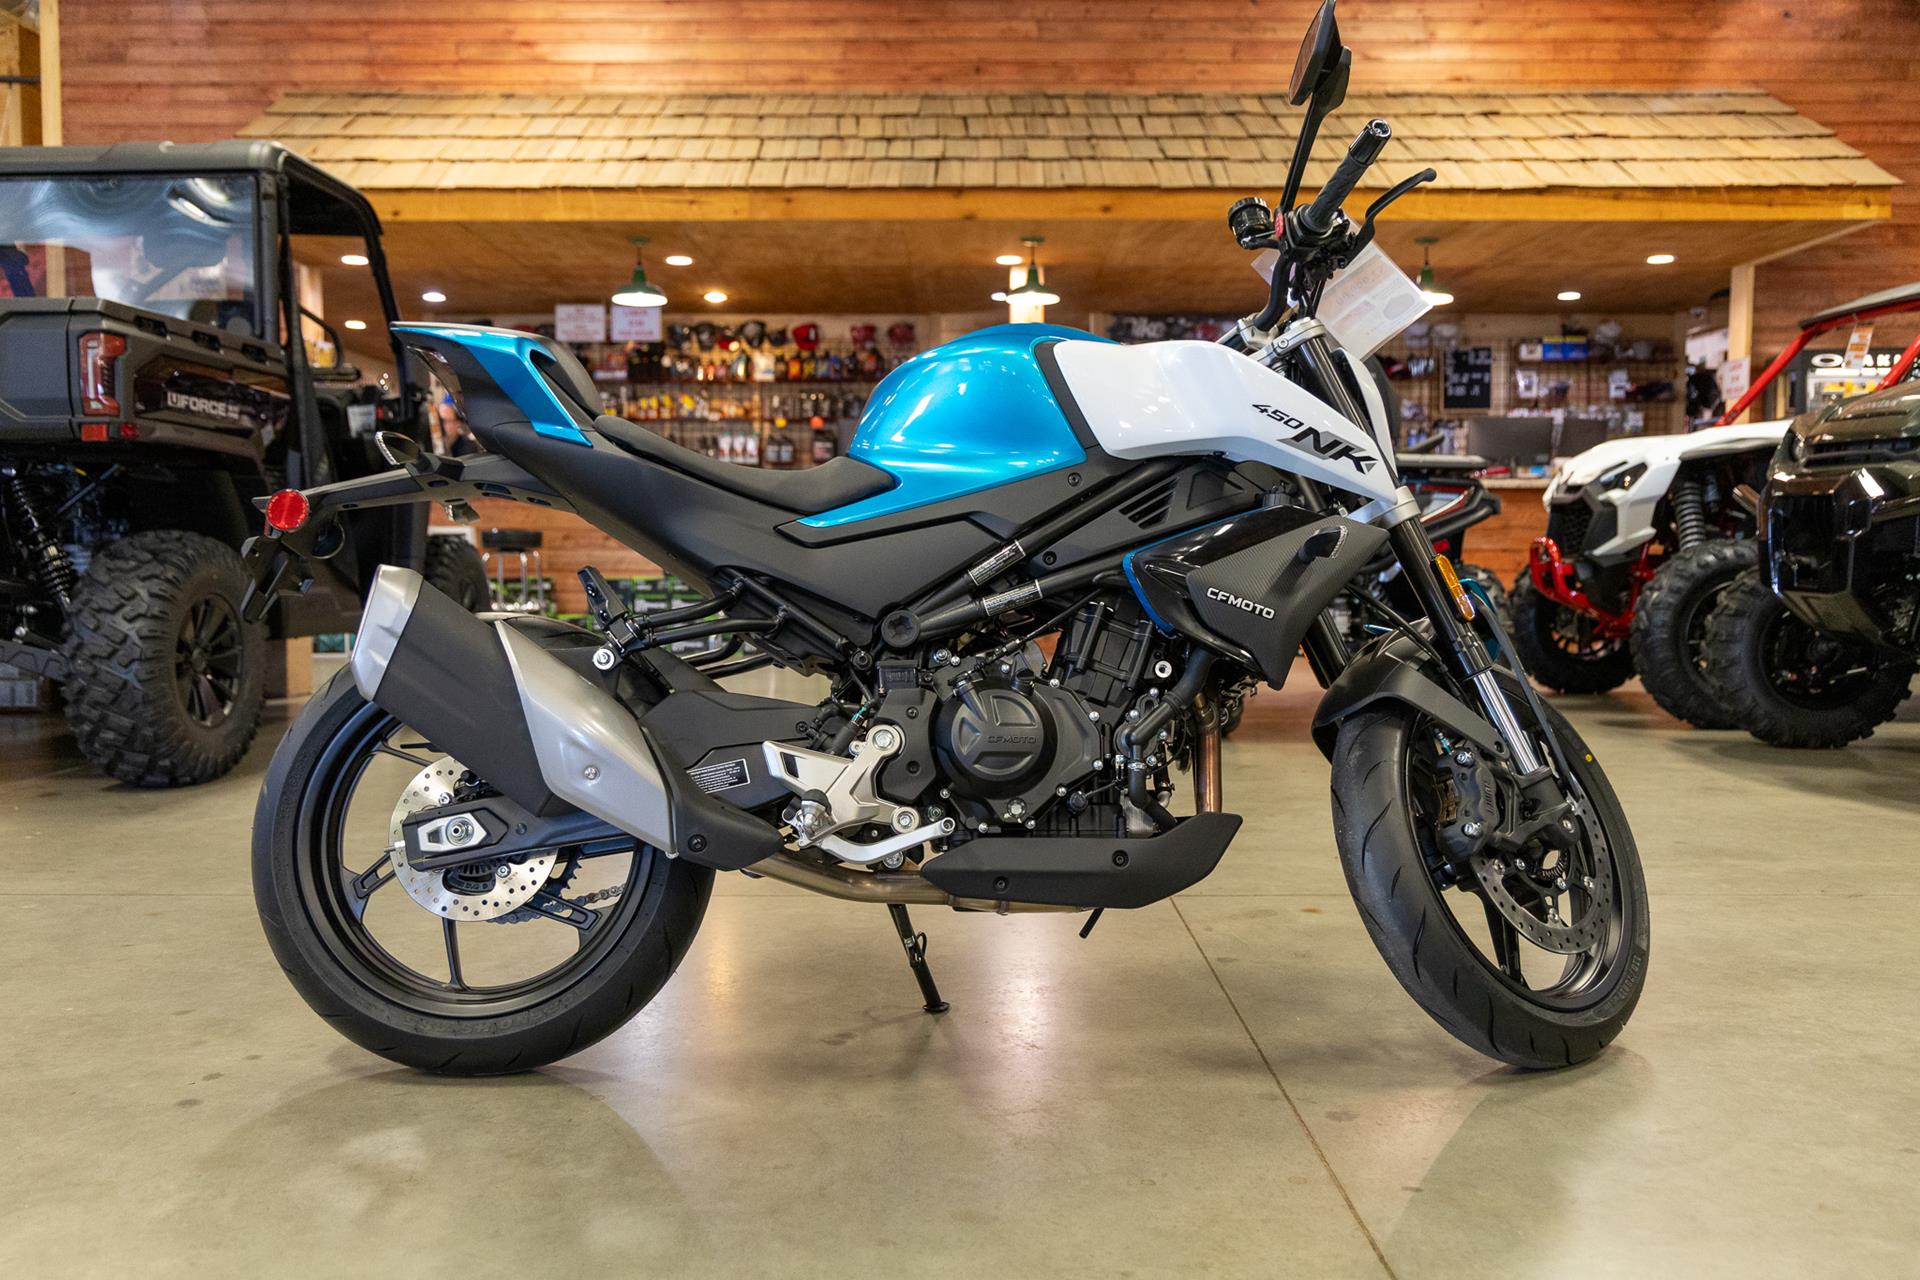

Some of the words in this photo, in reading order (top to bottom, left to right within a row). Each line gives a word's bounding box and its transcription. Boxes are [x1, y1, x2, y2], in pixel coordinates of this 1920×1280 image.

[167, 391, 226, 417] UFORCE
[1252, 403, 1304, 430] 450
[1291, 426, 1378, 475] NK
[1206, 587, 1275, 619] CFMOTO
[987, 735, 1037, 744] CFMOTO
